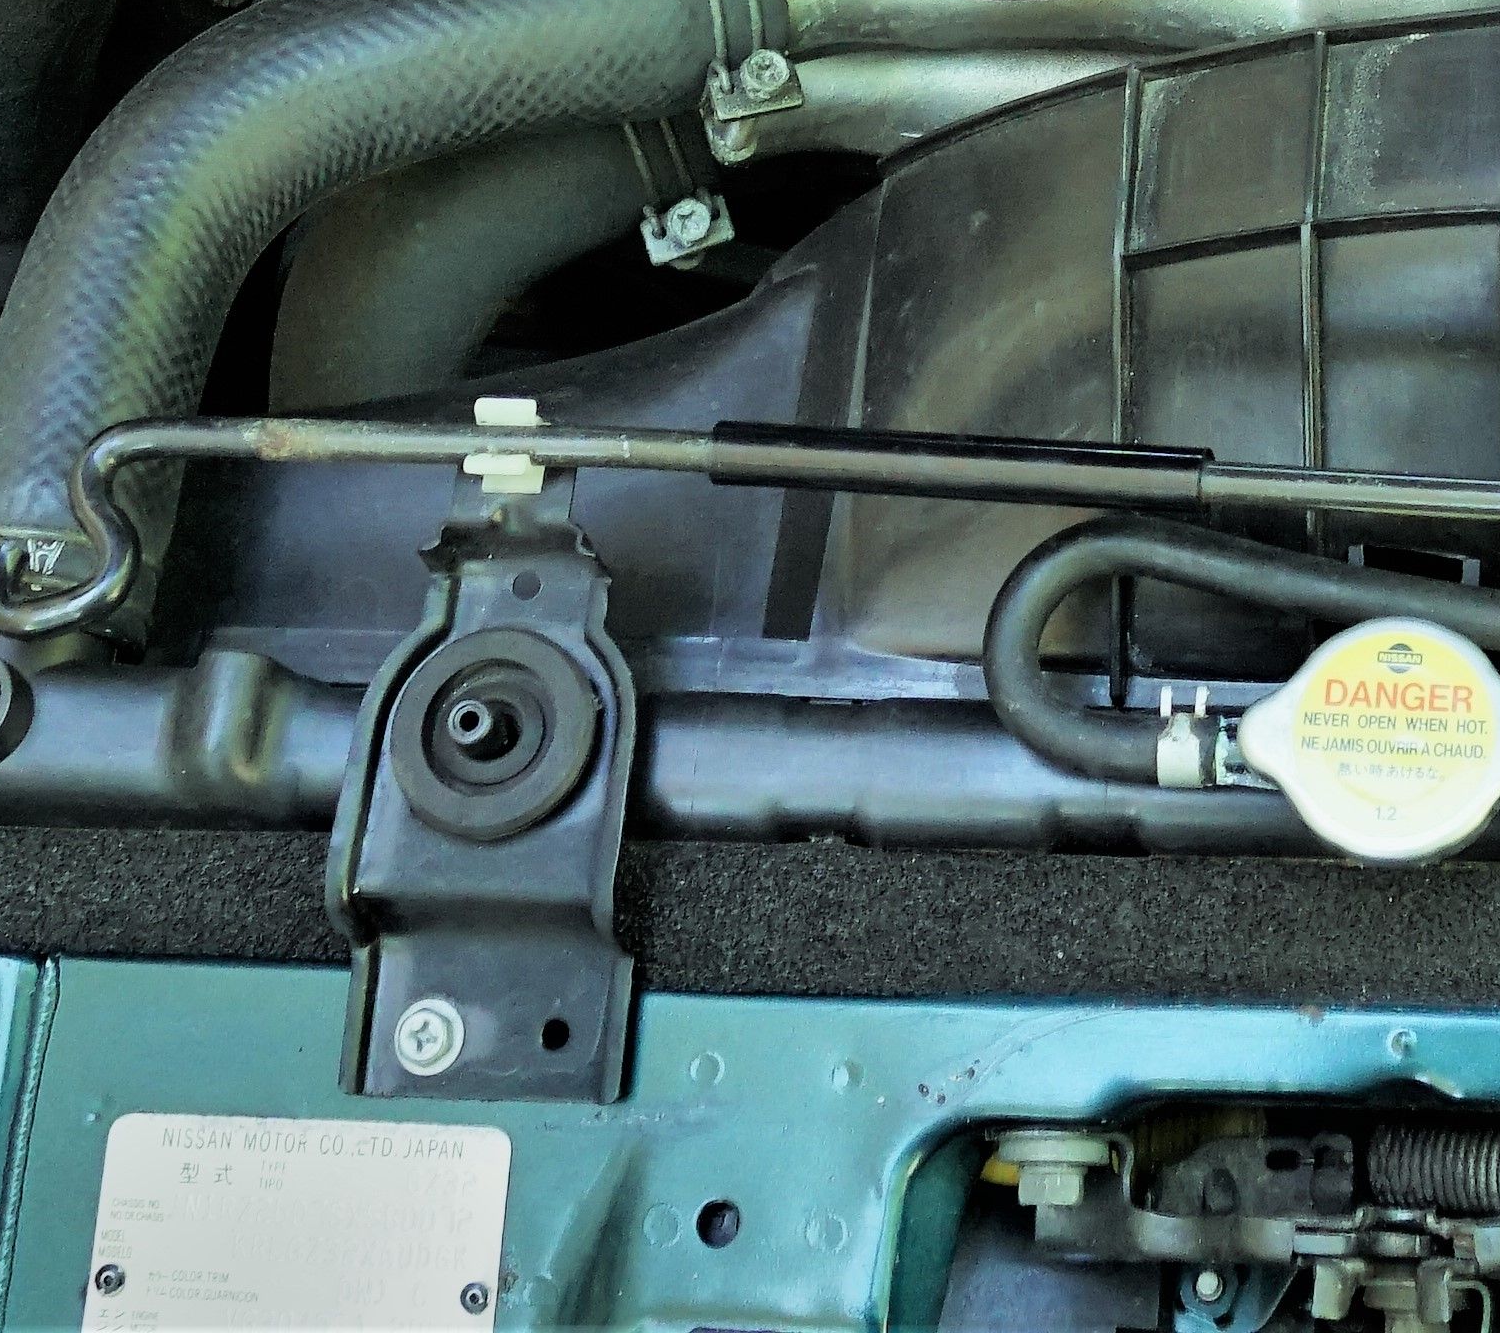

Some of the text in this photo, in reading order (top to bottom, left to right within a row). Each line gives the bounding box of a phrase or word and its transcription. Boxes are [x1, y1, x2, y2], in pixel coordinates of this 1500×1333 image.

[1378, 652, 1422, 665] NISSAN
[1324, 678, 1474, 713] DANGER
[1303, 711, 1488, 735] NEVER OPEN WHEN HOT.
[1301, 736, 1487, 760] NE JAMIS OUVRIR A CHAUD.
[1374, 806, 1398, 822] 1.2
[162, 1127, 232, 1151] NISSAN
[243, 1132, 308, 1153] MOTOR
[403, 1139, 465, 1160] JAPAN
